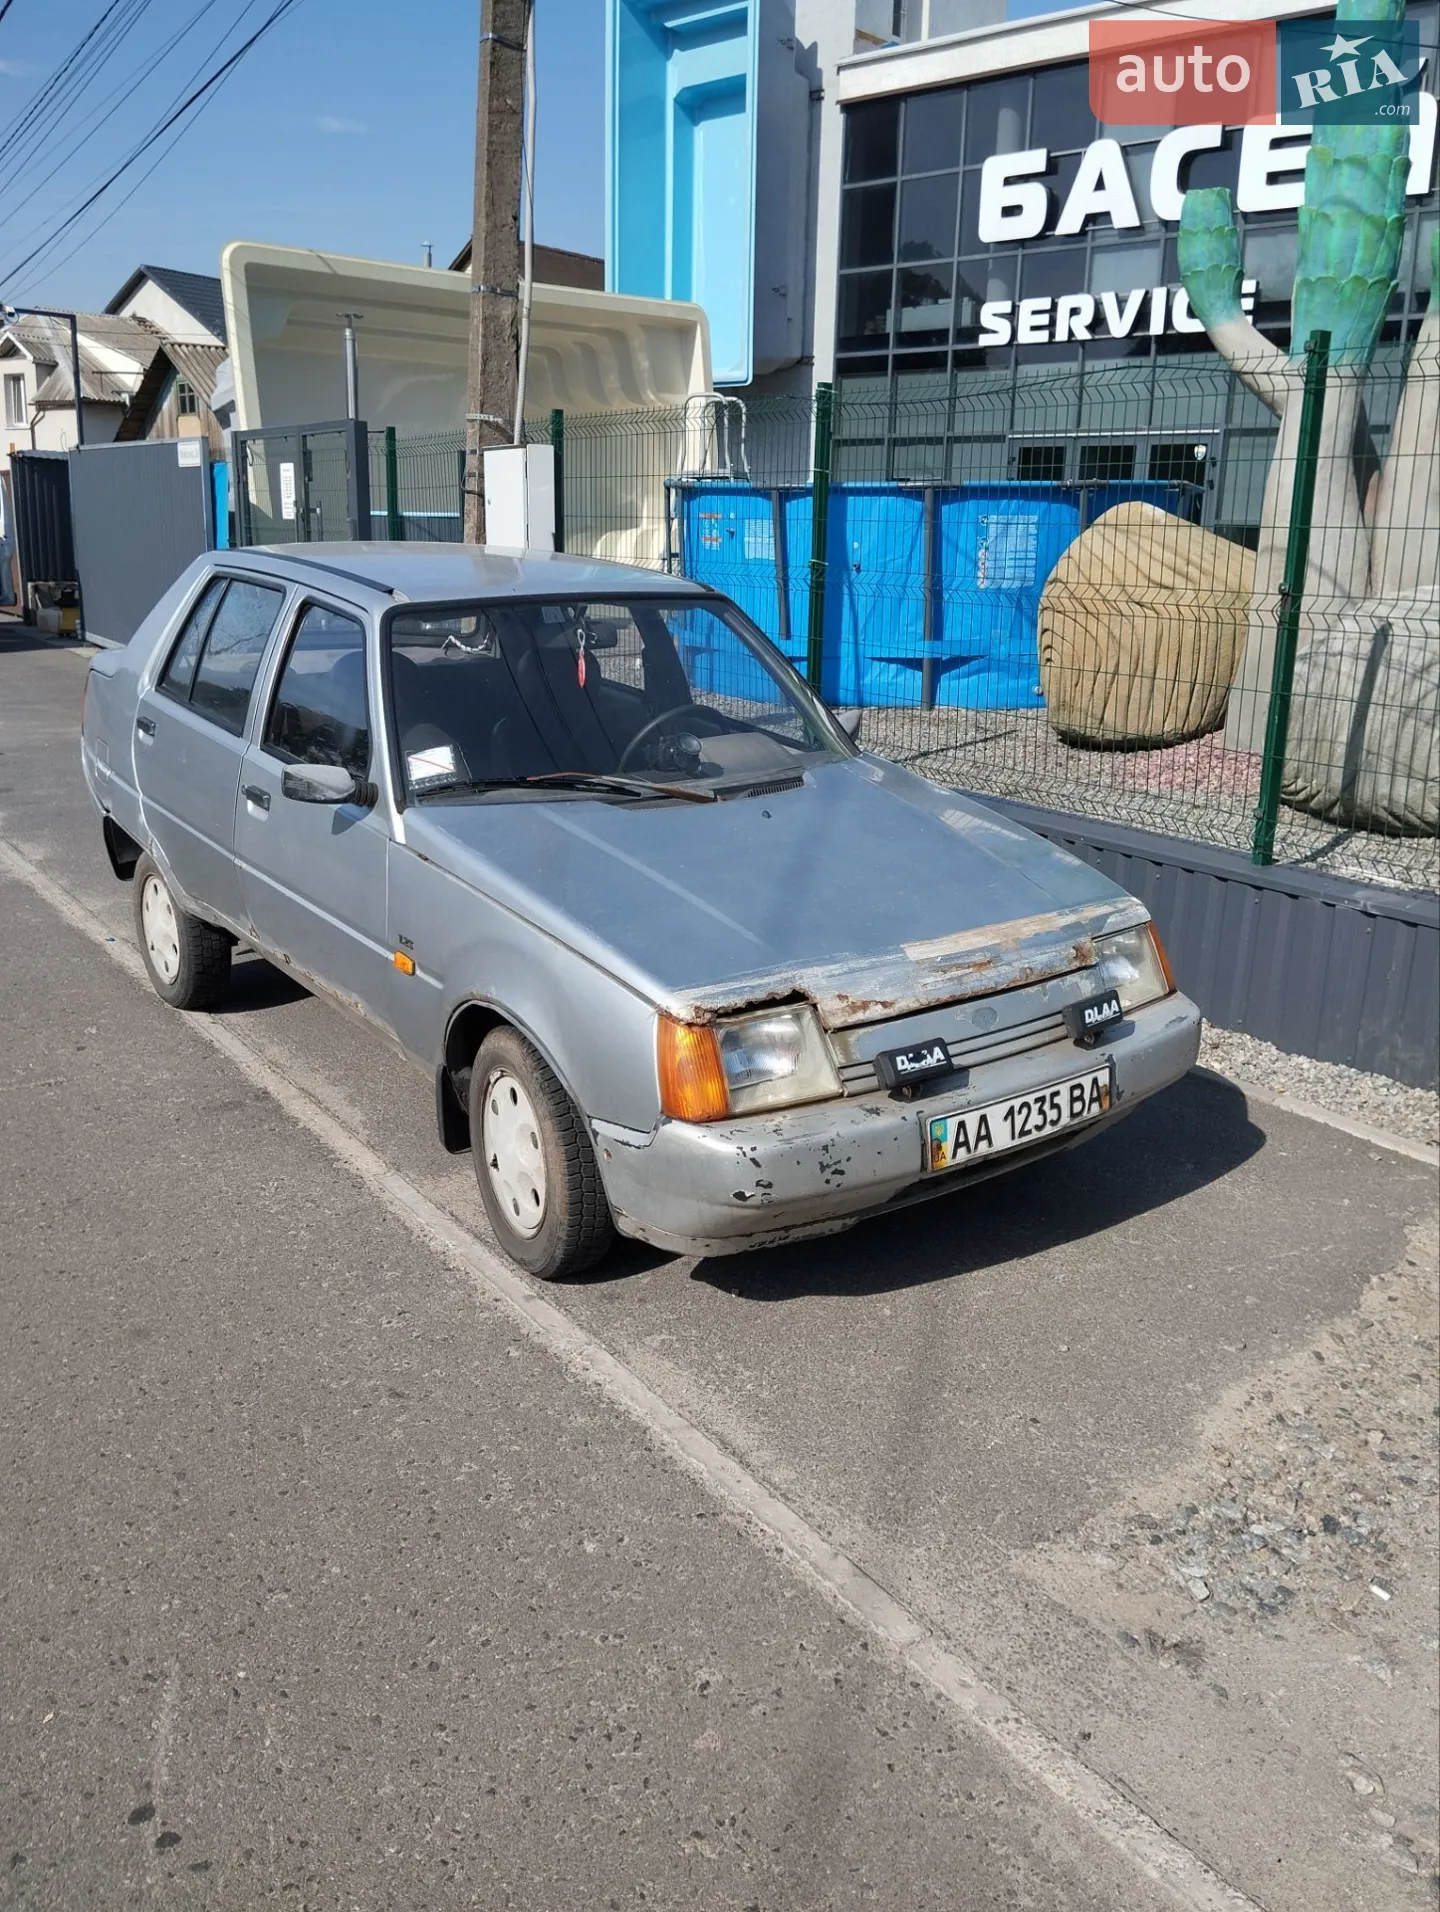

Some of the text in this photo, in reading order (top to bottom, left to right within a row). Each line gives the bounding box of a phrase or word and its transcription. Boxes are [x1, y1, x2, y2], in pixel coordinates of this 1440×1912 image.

[951, 1075, 1103, 1160] AA 1235 BA
